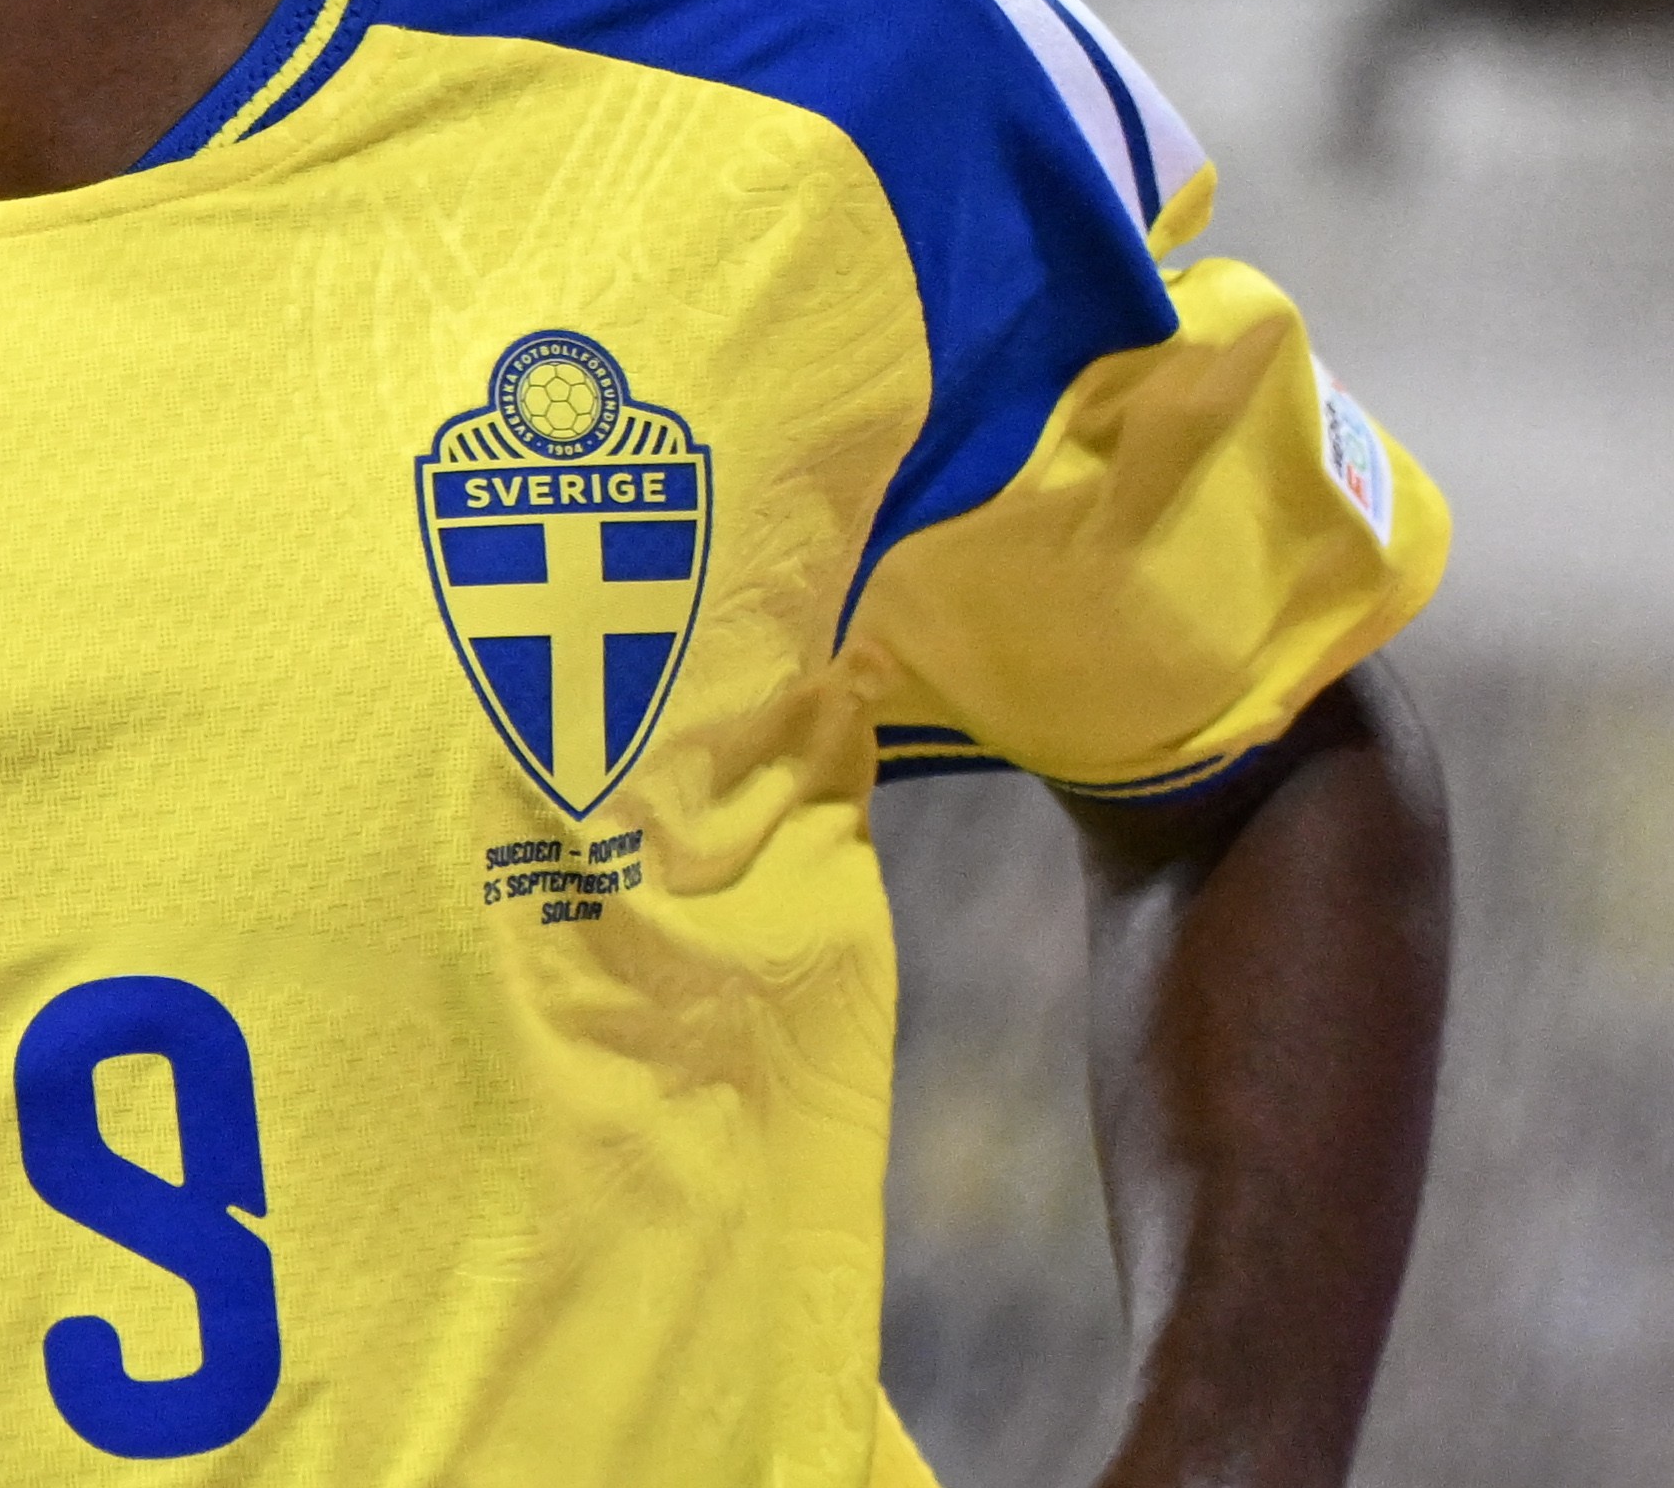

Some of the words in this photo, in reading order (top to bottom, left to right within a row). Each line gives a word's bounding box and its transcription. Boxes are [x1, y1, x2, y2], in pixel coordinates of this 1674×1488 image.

[502, 374, 534, 442] SVENSKA
[513, 344, 618, 441] FOTBOLLFÖRBUNDET
[547, 443, 585, 456] 1904
[464, 472, 666, 509] SVERIGE
[486, 840, 562, 870] SWEDEN
[484, 879, 501, 905] 25
[507, 871, 619, 898] SEPTEMBER
[541, 900, 603, 924] SOLNA
[14, 975, 282, 1459] 9
